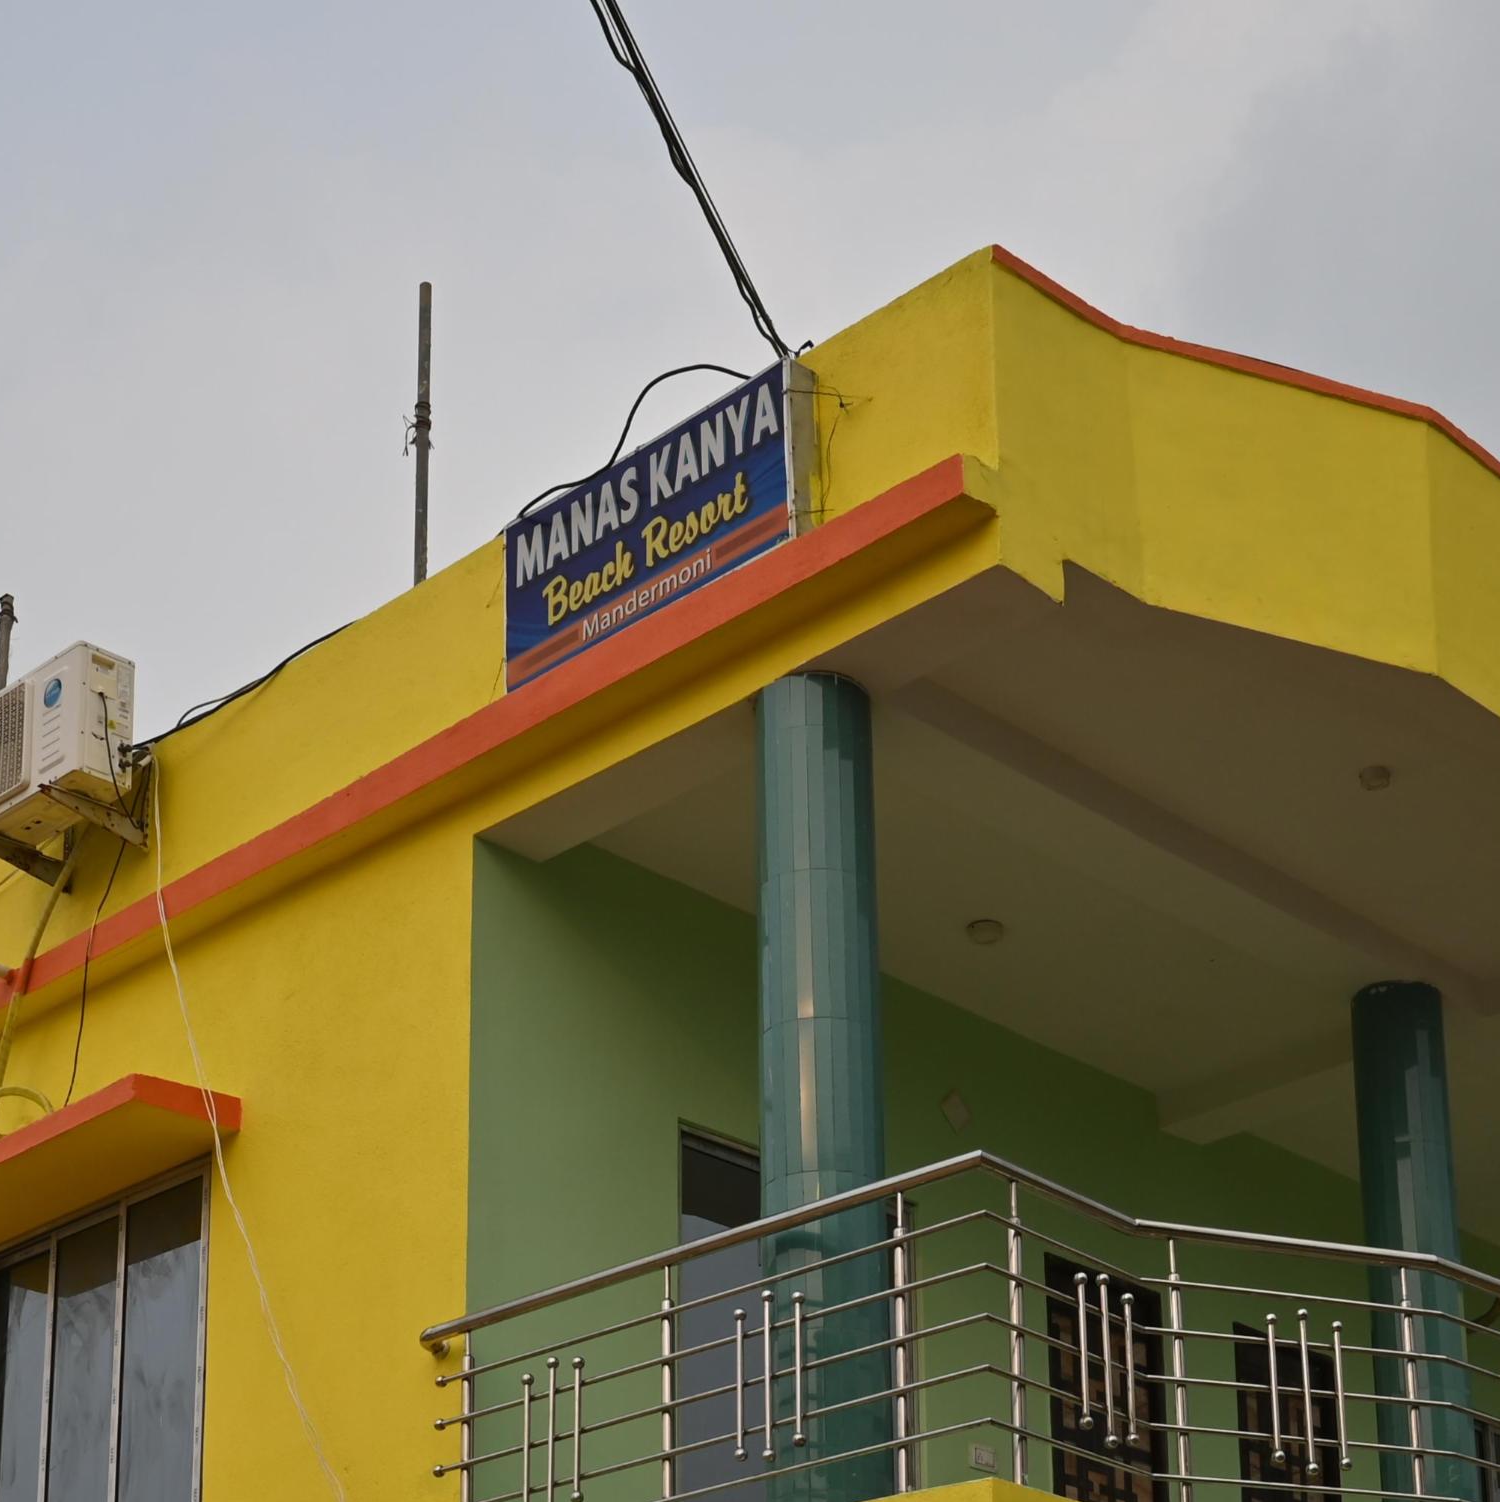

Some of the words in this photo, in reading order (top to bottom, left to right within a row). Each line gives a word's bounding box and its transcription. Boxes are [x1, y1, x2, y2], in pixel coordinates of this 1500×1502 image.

[515, 465, 640, 589] MANAS
[650, 382, 779, 507] KANYA
[542, 541, 635, 626] Beach
[641, 471, 748, 567] Resort
[581, 548, 713, 642] Mandermoni
